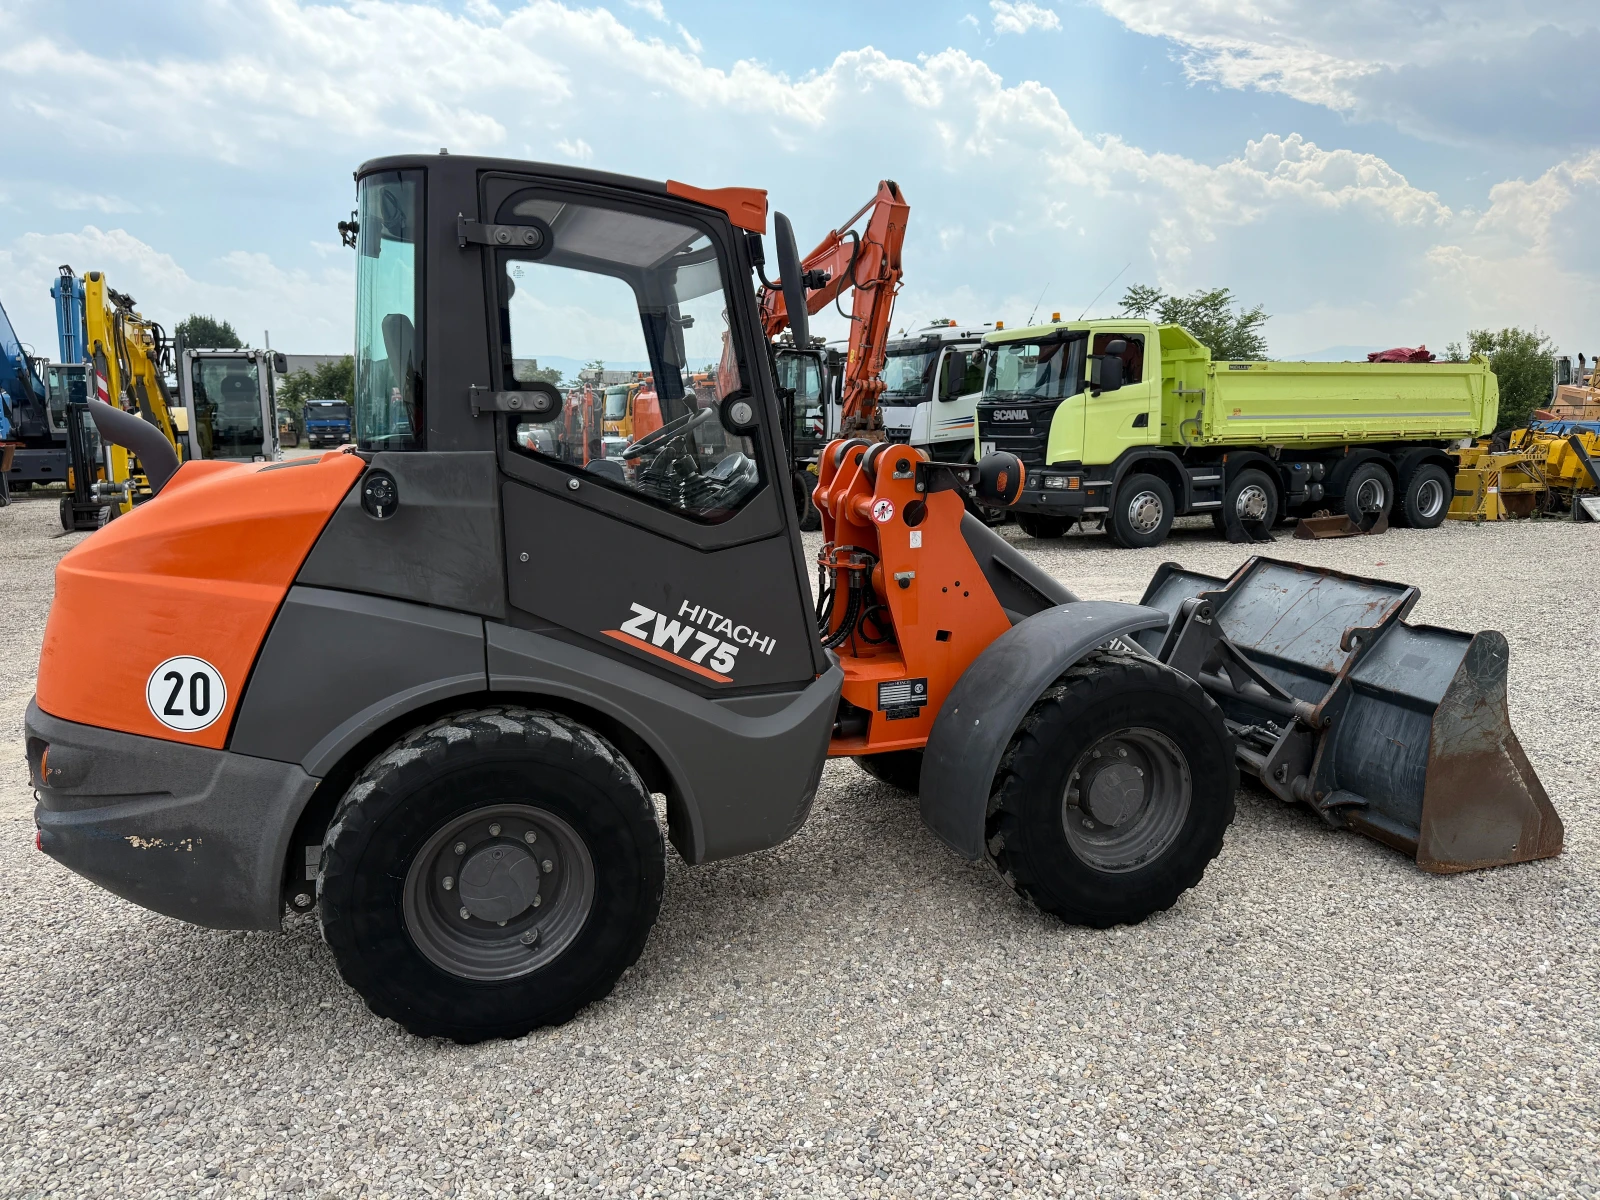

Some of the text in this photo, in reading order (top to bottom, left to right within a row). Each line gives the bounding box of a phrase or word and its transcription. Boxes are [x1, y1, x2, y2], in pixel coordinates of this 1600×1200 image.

[993, 410, 1029, 420] SCANIA
[620, 602, 740, 674] ZW75
[678, 600, 777, 656] HITACHI
[163, 671, 211, 716] 20
